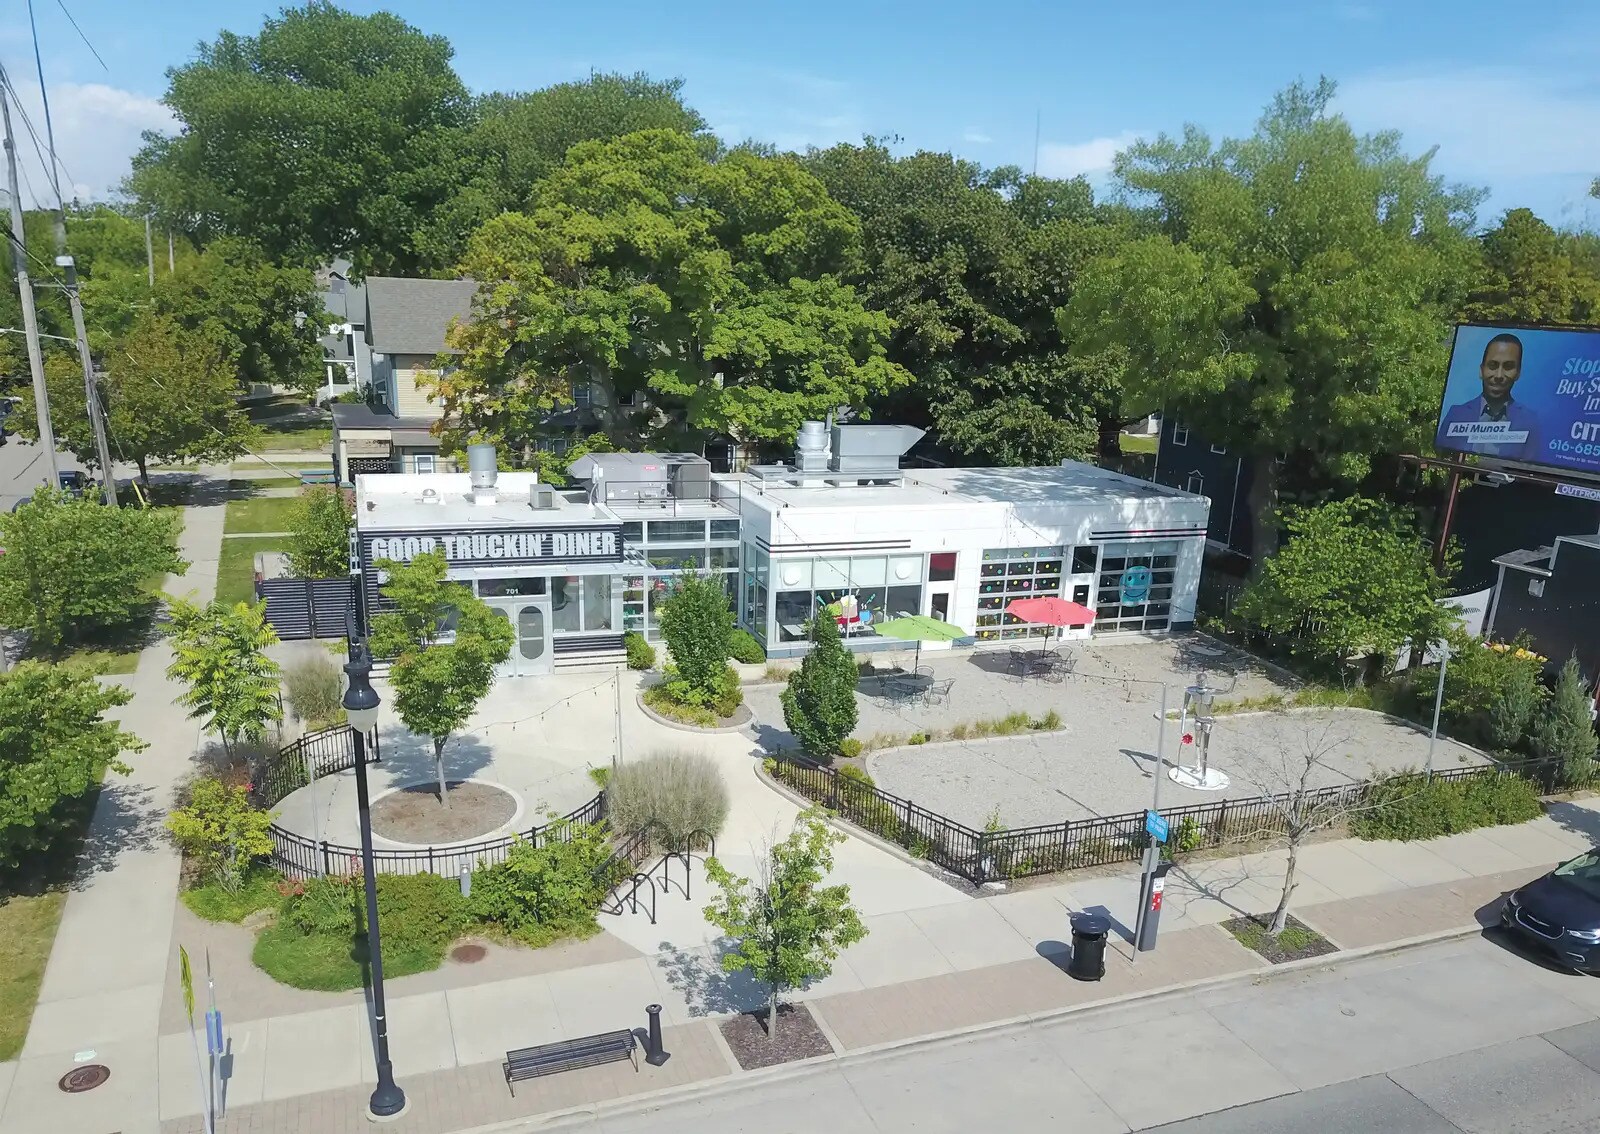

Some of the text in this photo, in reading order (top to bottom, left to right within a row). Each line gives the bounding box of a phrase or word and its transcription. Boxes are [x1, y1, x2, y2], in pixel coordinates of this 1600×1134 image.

[1556, 378, 1587, 398] Buy,
[1452, 423, 1506, 433] Abi Munoz
[371, 537, 436, 561] GOOD
[552, 532, 617, 557] DINER
